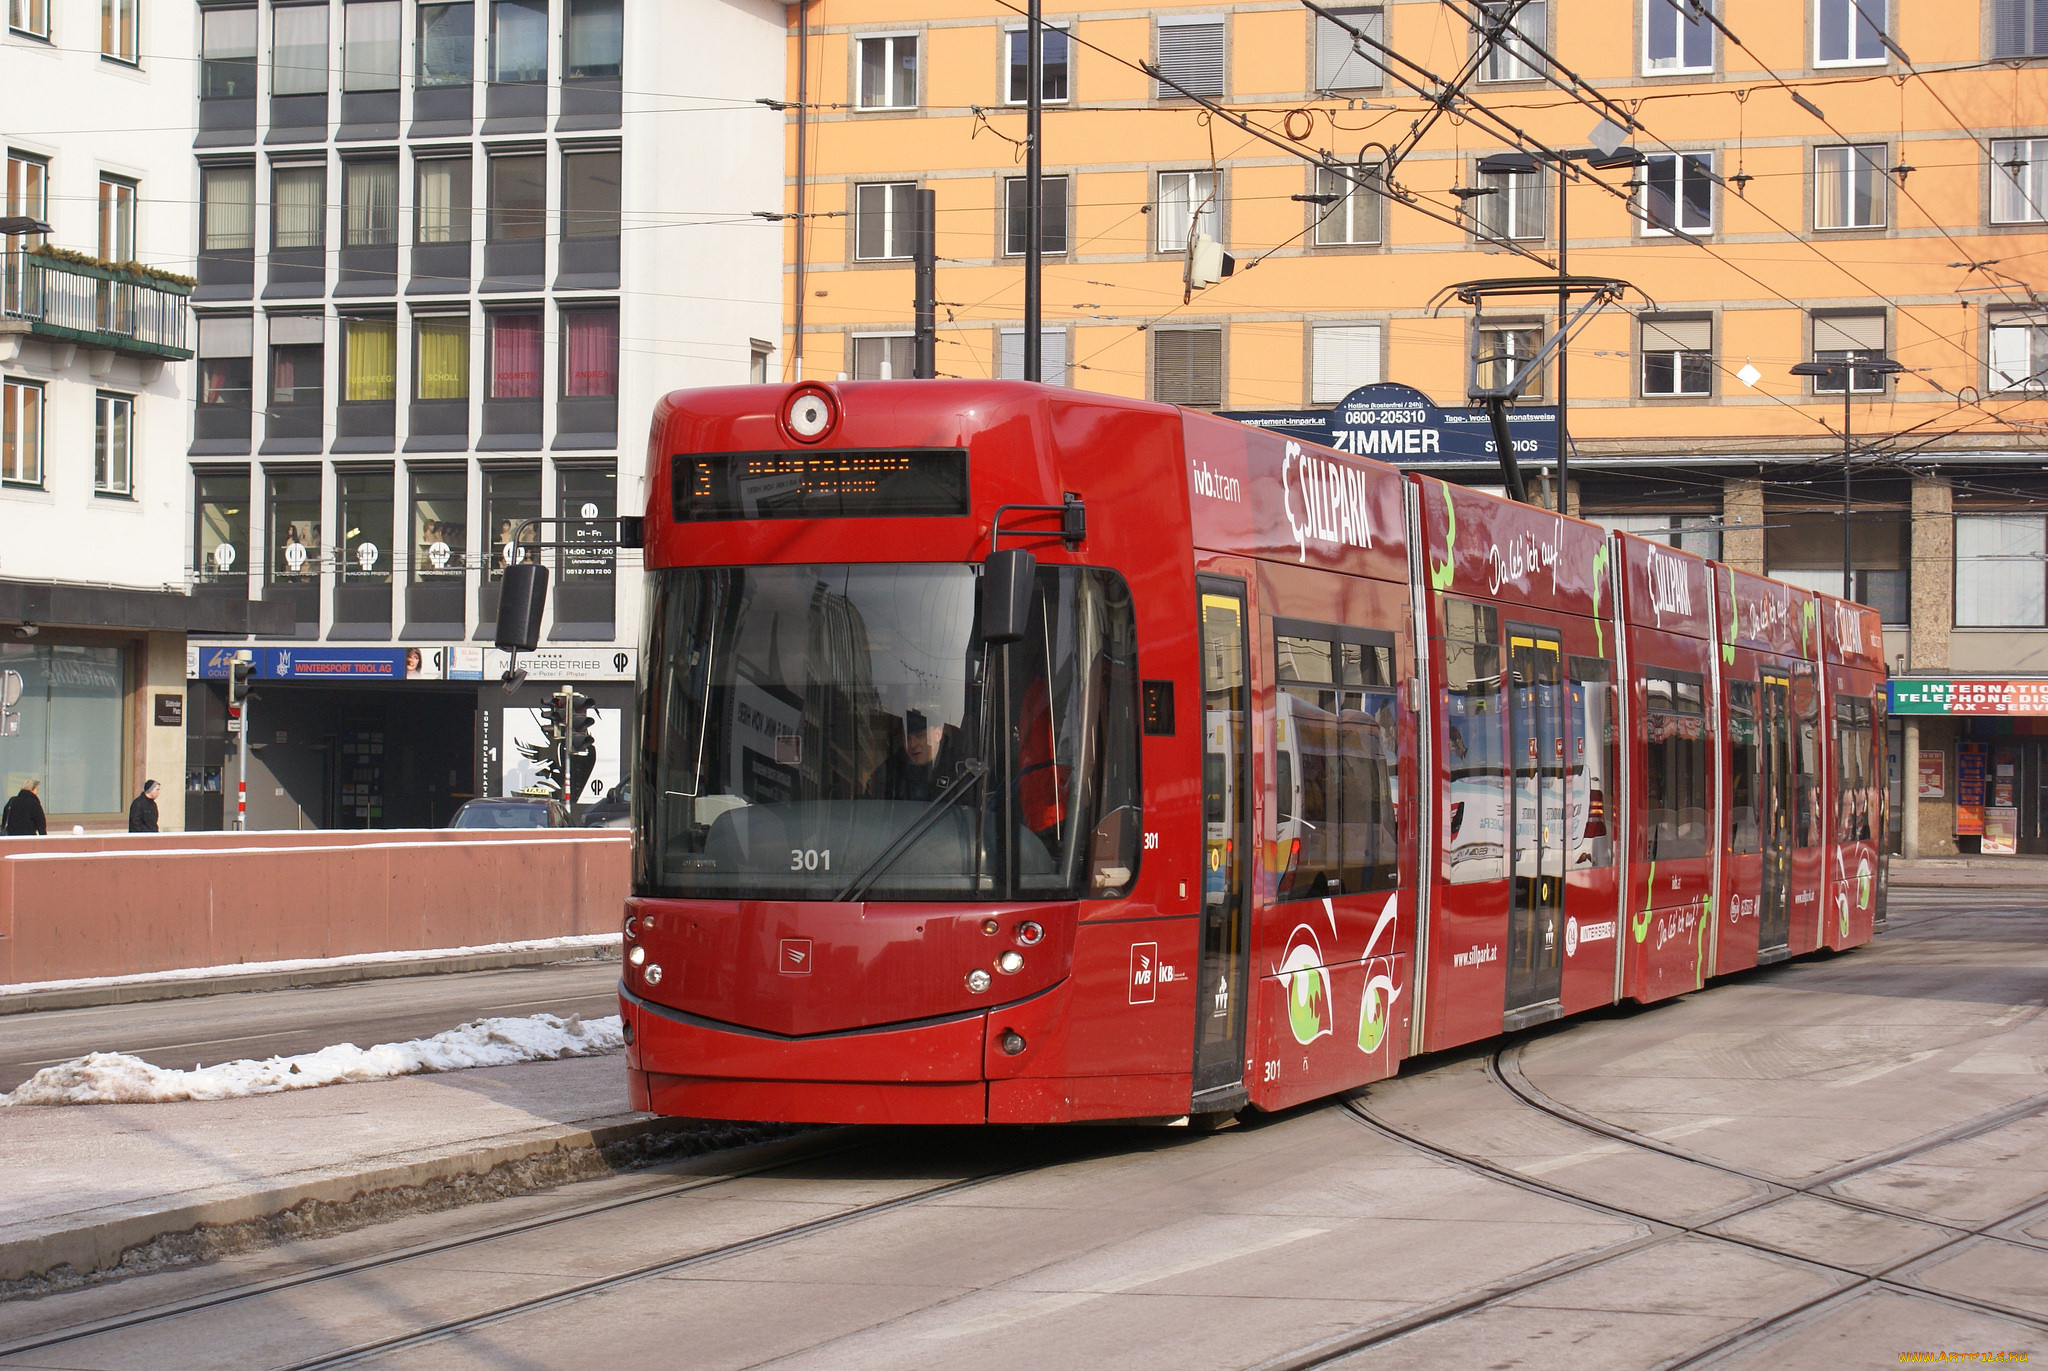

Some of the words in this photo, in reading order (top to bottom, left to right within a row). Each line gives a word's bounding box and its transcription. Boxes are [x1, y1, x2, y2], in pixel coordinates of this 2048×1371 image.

[427, 373, 459, 382] SCHOLL
[497, 371, 538, 381] KOSMETIK
[575, 370, 609, 379] ANDREA
[1347, 402, 1370, 410] Hotline
[1345, 410, 1426, 424] 0800-205310
[1332, 429, 1440, 454] ZIMMER
[1193, 459, 1241, 503] ivb.tram
[1300, 454, 1373, 549] SILLPARK
[1488, 544, 1508, 595] Da
[1526, 530, 1540, 573] ich
[1655, 553, 1692, 616] SILLPARK
[295, 663, 351, 673] WINTERSPORT
[354, 662, 378, 673] TIROL
[378, 662, 392, 672] AG
[499, 660, 601, 669] MISTERBETRIEB
[1897, 693, 2012, 703] TELEPHONE
[1943, 703, 1976, 711] FAX
[488, 747, 497, 762] 1
[1144, 833, 1159, 849] 301
[790, 849, 831, 871] 301
[1453, 943, 1498, 969] www.sillpark.at
[1134, 969, 1152, 985] IVB
[1263, 1059, 1281, 1082] 301
